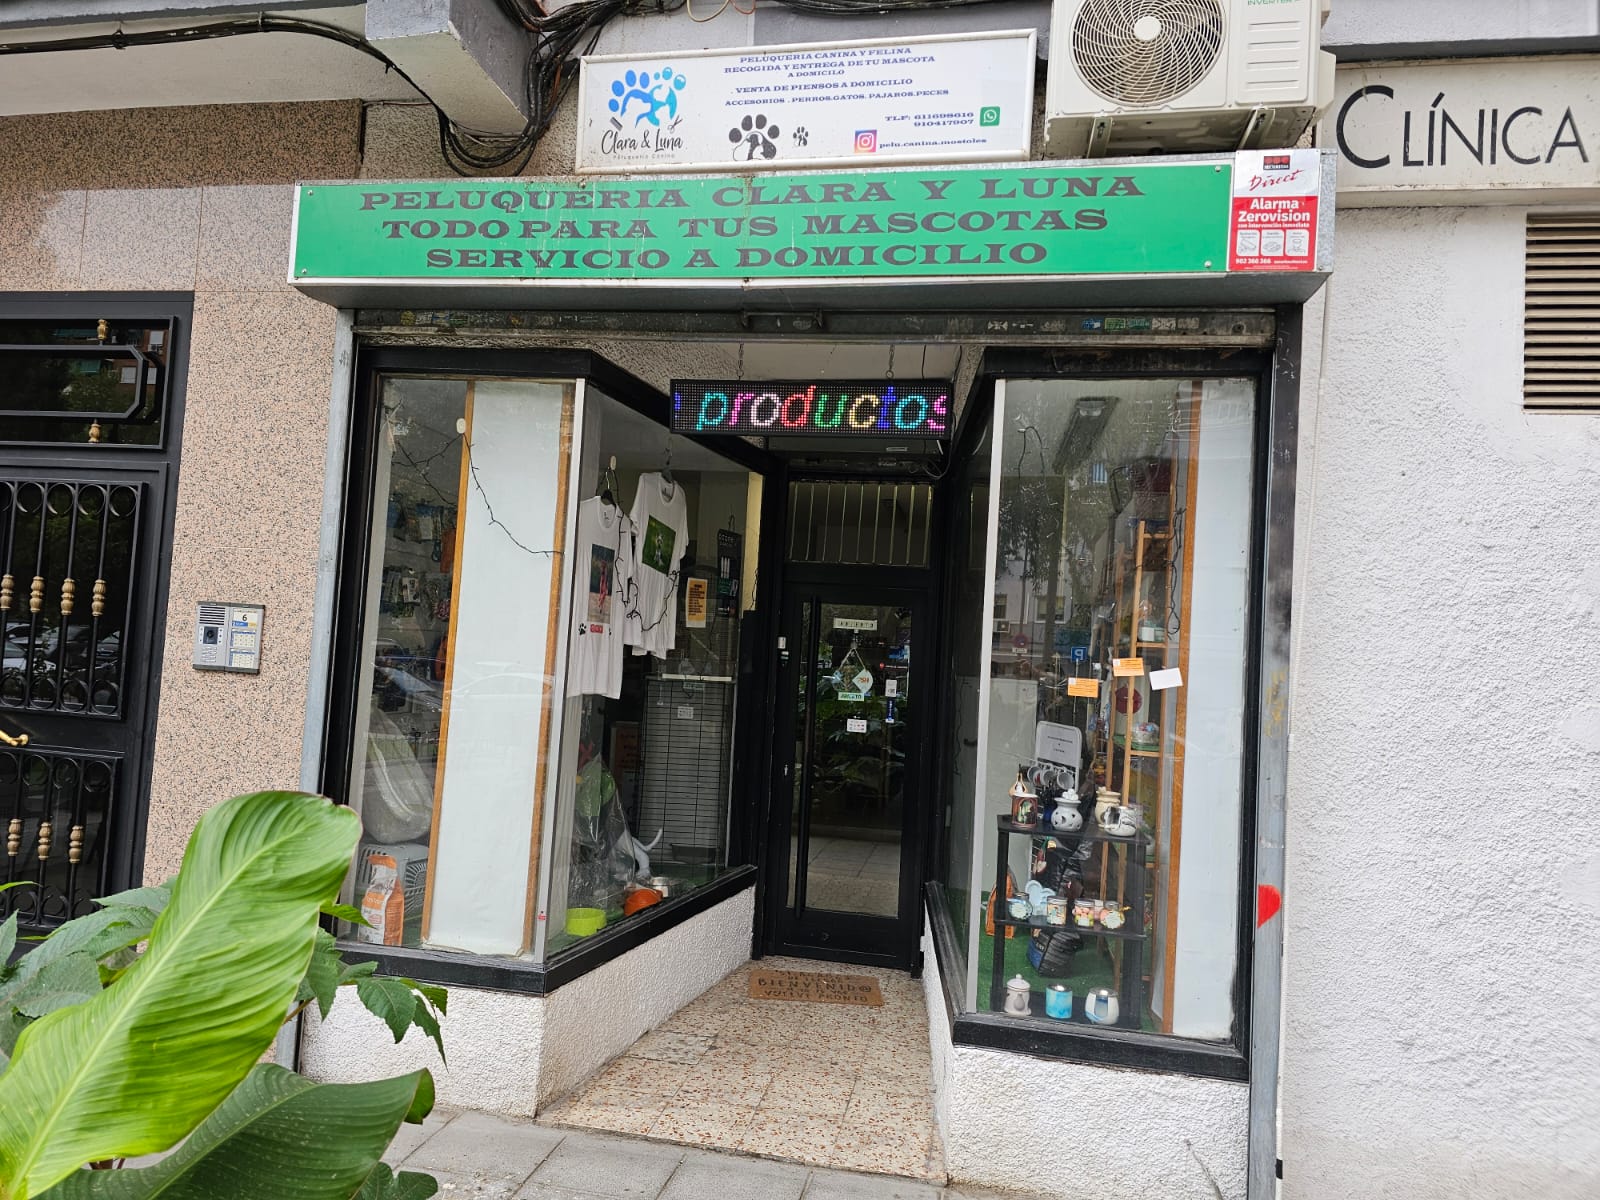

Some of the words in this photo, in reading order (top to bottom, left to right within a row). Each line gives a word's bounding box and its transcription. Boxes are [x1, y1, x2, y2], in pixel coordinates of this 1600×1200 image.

[724, 65, 781, 74] RECOGIDA
[792, 61, 846, 70] ENTREGA
[882, 56, 936, 65] MASCOTA
[740, 53, 812, 63] PELUQUERIA
[814, 51, 857, 59] CANINA
[868, 47, 912, 56] FELINA
[796, 69, 845, 77] DOMICILO
[735, 85, 771, 93] VENTA
[790, 82, 839, 91] PIENSOS
[850, 78, 913, 88] DOMICILIO
[1336, 85, 1590, 169] CLÍNICA
[601, 129, 638, 155] Clara
[641, 129, 651, 148] &
[654, 128, 684, 152] Luna
[1249, 169, 1305, 191] Direct
[359, 189, 691, 213] PELUQUERIA
[712, 181, 896, 207] CLARA
[919, 179, 960, 200] Y
[980, 176, 1146, 200] LUNA
[1250, 198, 1299, 210] Alarma
[382, 218, 510, 239] TODO
[517, 218, 657, 240] PARA
[678, 215, 778, 238] TUS
[801, 208, 1108, 235] MASCOTAS
[1238, 210, 1311, 223] Zerovision
[426, 247, 671, 270] SERVICIO
[683, 248, 720, 270] A
[735, 242, 1048, 269] DOMICILIO
[695, 385, 947, 431] productos
[242, 614, 248, 622] 6
